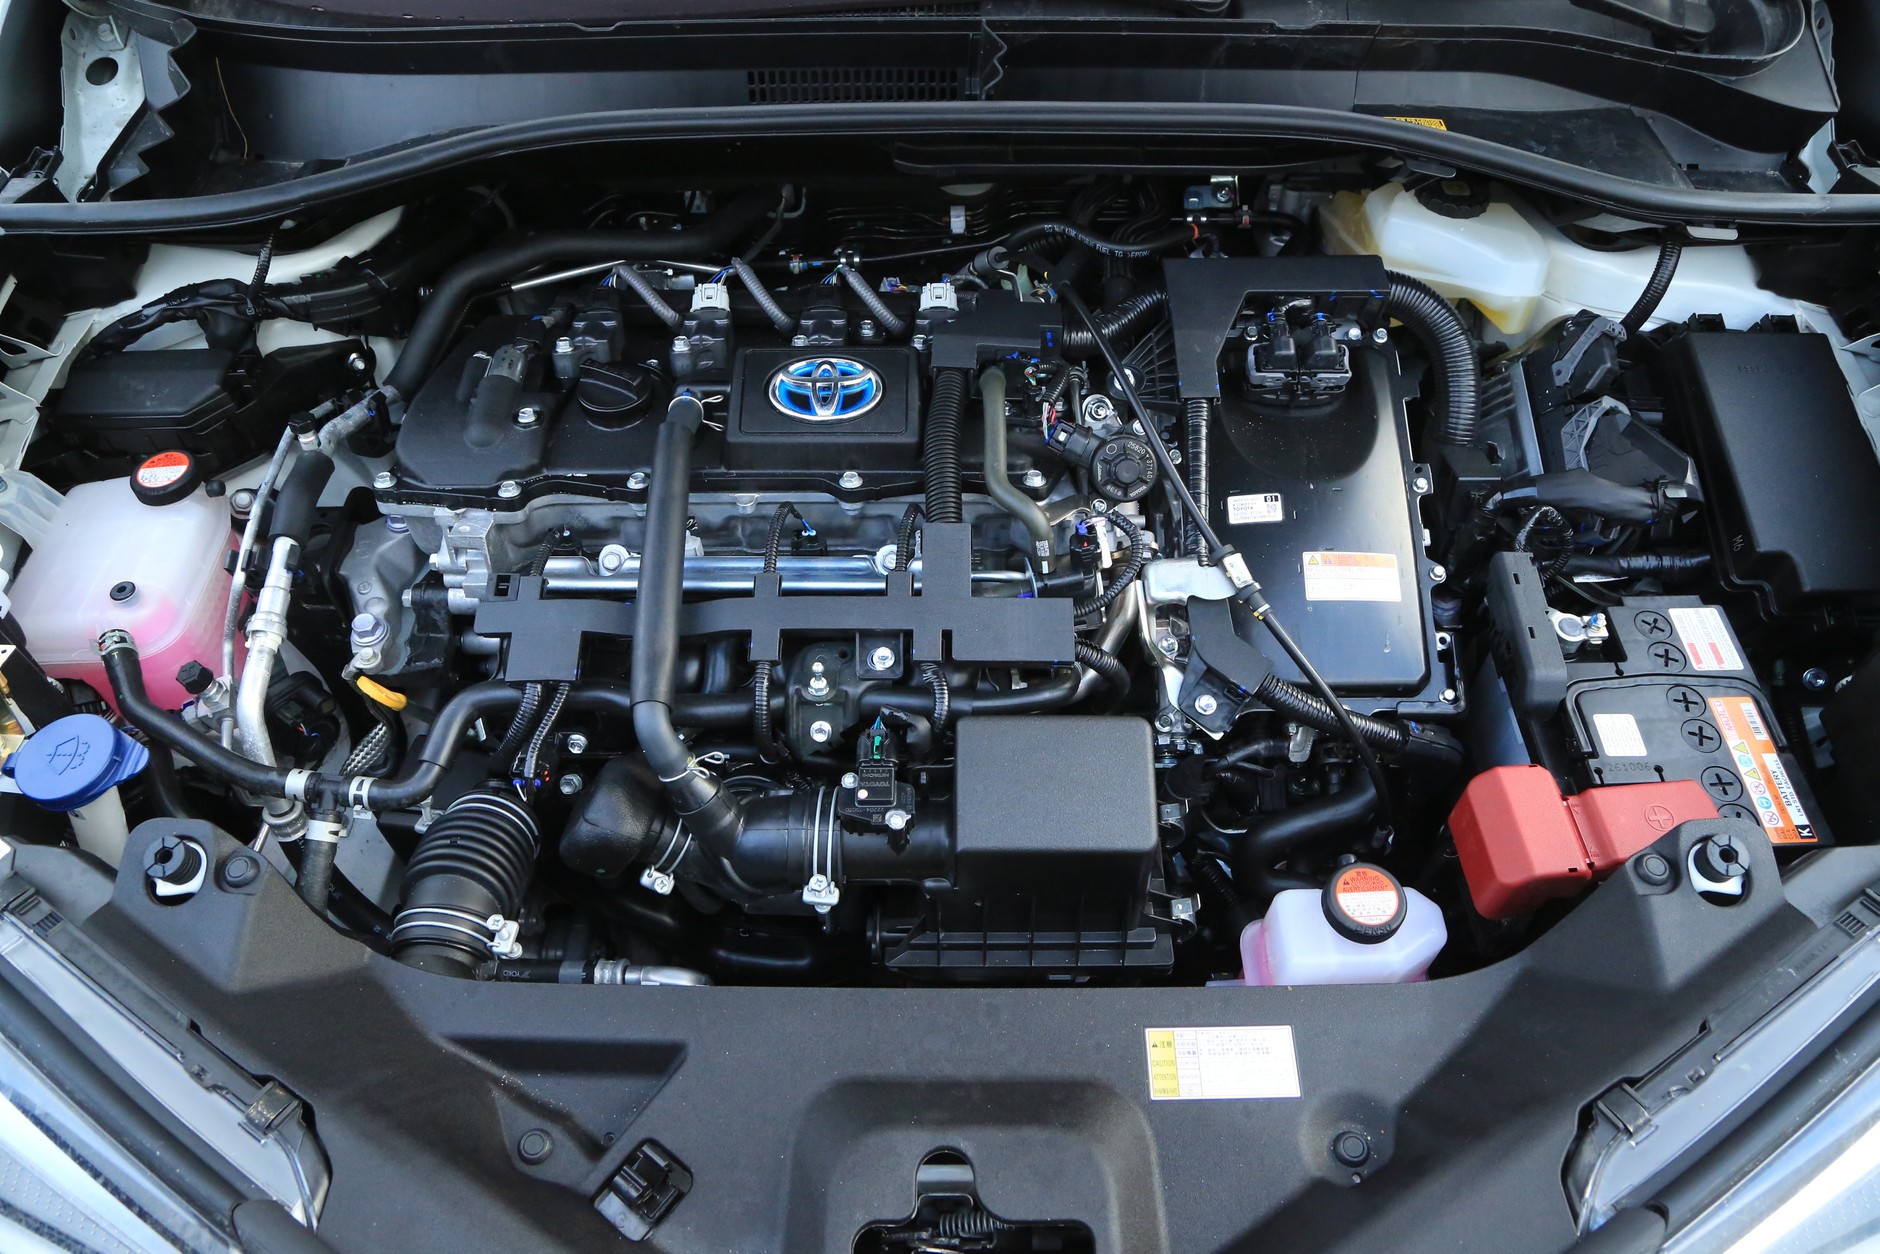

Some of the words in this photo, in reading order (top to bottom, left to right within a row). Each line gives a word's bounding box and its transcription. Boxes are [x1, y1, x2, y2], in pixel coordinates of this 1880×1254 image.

[1129, 485, 1148, 498] TOYOTA
[1770, 769, 1792, 807] BATTERY
[1798, 827, 1813, 836] K
[1342, 885, 1388, 893] AVERTISSEMENT
[1355, 924, 1392, 936] DENSO
